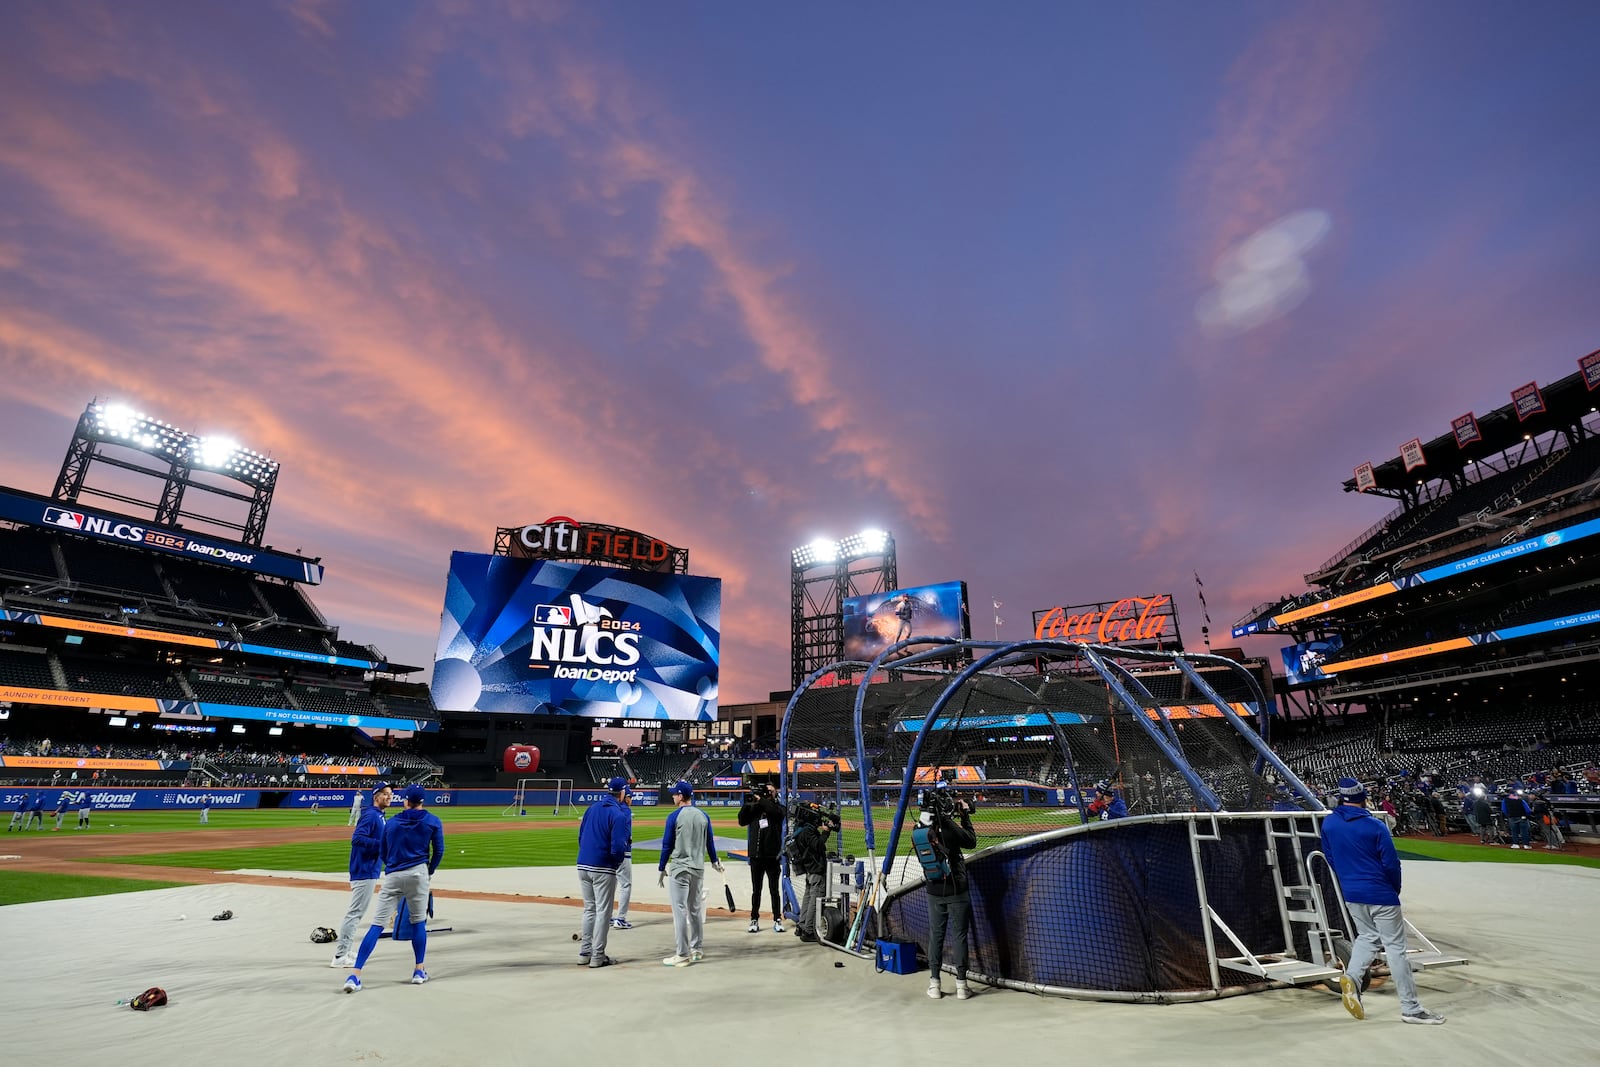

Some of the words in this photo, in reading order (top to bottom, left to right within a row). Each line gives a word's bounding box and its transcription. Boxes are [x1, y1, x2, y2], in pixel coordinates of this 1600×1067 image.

[84, 516, 143, 541] NLCS
[144, 533, 185, 548] 2024
[186, 541, 254, 564] loanDepot
[520, 522, 579, 553] citi
[586, 532, 668, 562] FIELD
[1480, 553, 1500, 563] CLEAN
[1500, 545, 1525, 557] UNLESS
[601, 620, 641, 631] 2024
[1036, 594, 1170, 643] Coca-Cola
[529, 625, 640, 666] NLCS
[219, 676, 250, 685] PORCH
[554, 664, 636, 684] loanDepot
[42, 694, 91, 703] DETERGENT
[623, 720, 661, 728] SAMSUNG
[435, 795, 450, 803] citi
